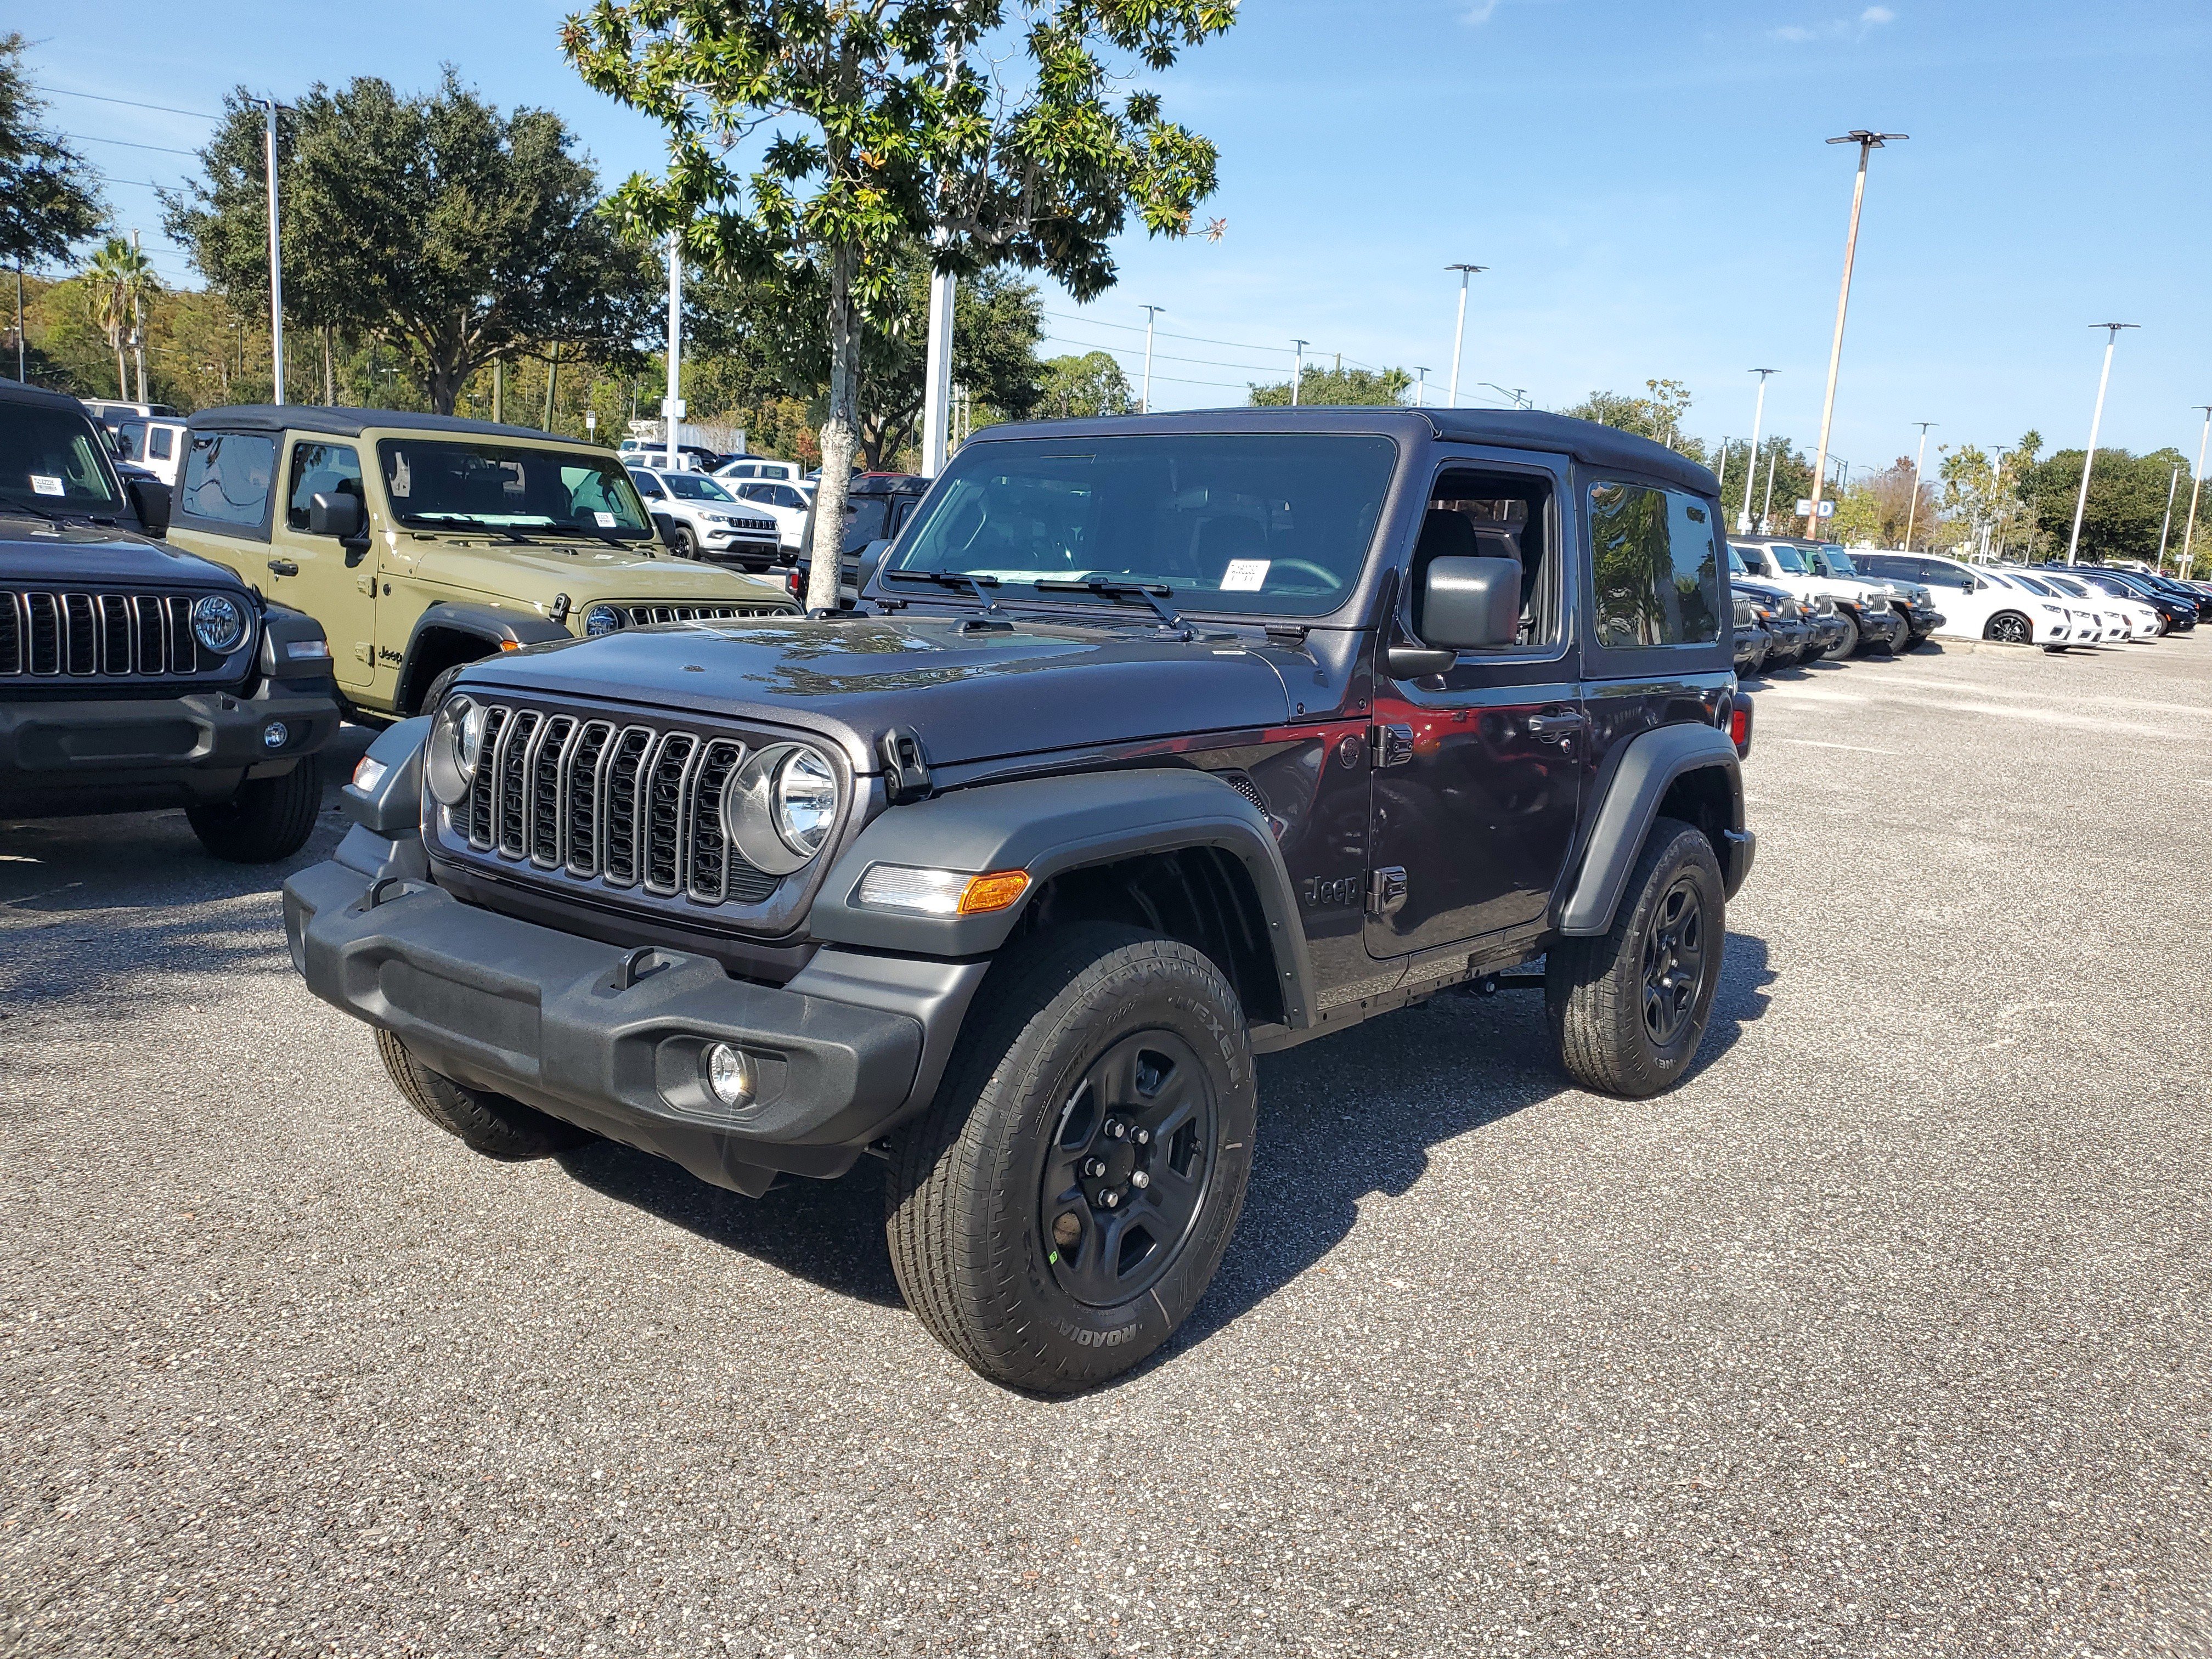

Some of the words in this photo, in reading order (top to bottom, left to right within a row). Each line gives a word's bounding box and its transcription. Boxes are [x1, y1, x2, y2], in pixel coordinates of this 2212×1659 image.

[1797, 500, 1811, 515] E
[1819, 501, 1832, 516] D
[379, 646, 403, 665] Jeep
[1305, 876, 1358, 906] Jeep
